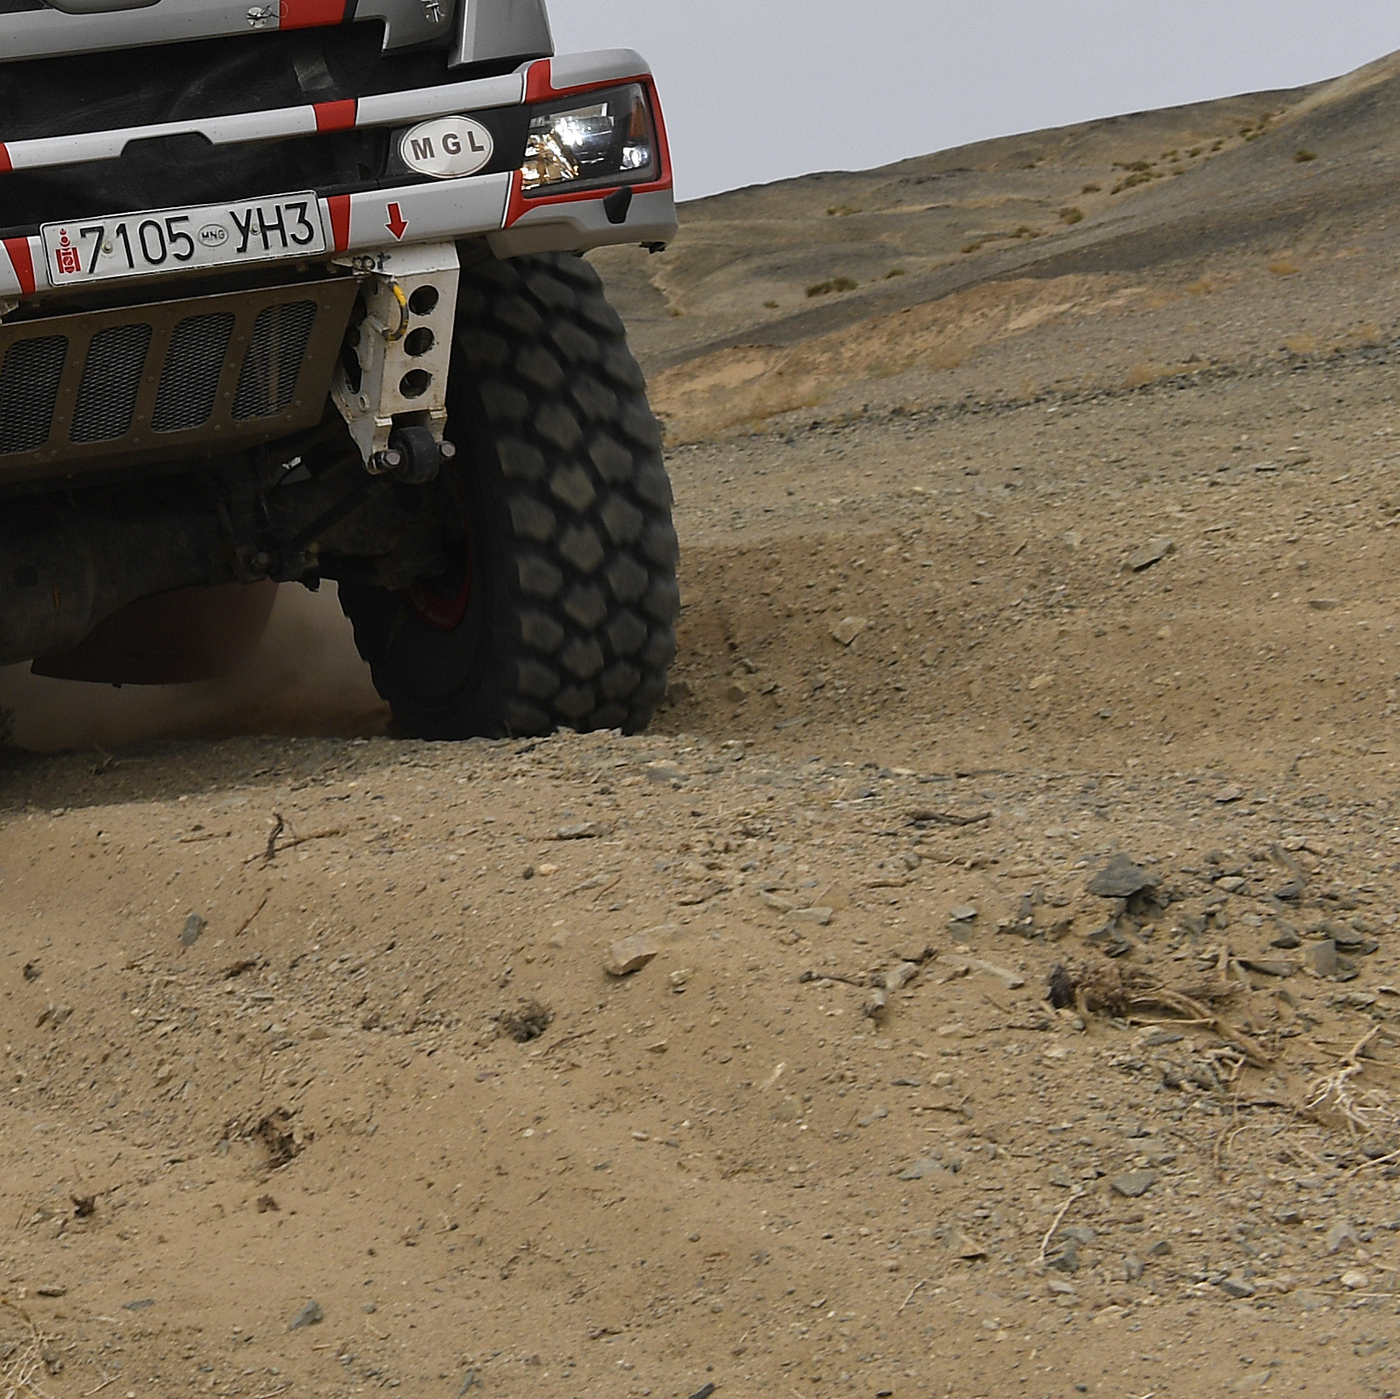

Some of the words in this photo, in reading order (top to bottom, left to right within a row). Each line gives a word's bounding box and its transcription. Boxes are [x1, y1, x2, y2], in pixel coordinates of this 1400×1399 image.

[410, 130, 485, 161] MGL
[79, 215, 195, 275] 7105
[200, 228, 226, 241] MNG
